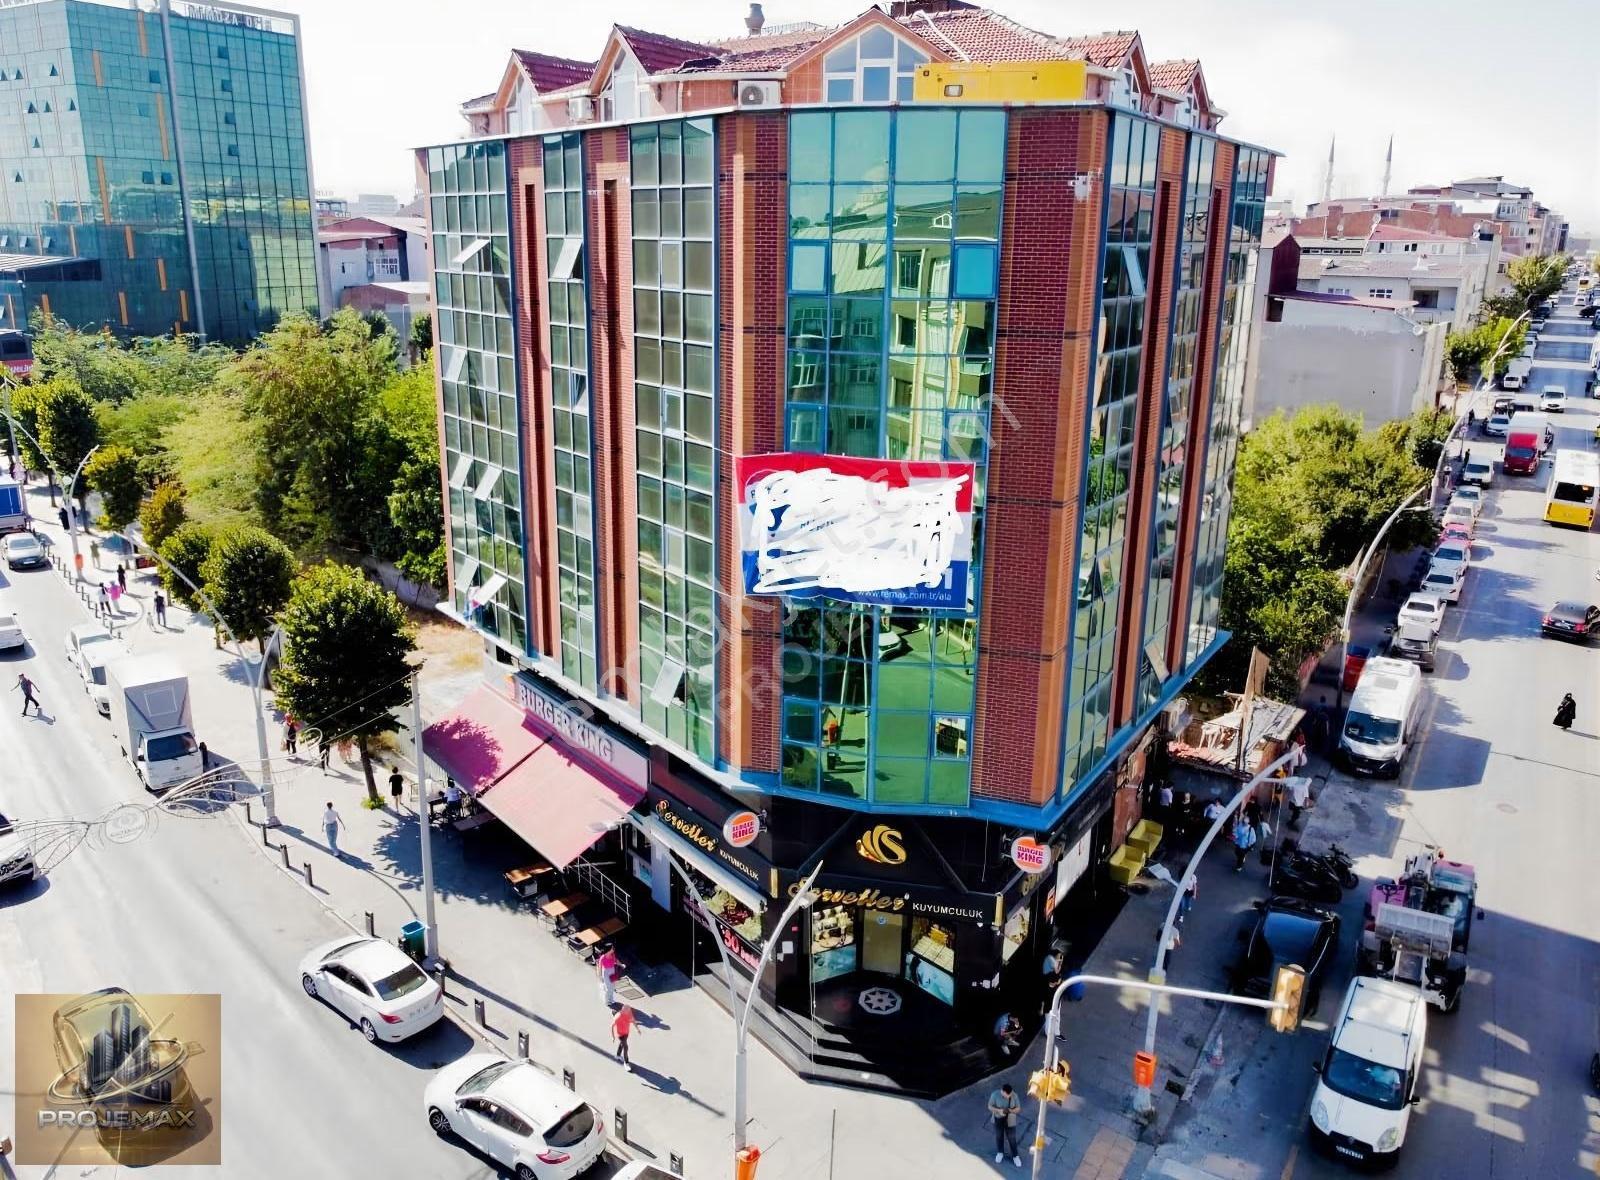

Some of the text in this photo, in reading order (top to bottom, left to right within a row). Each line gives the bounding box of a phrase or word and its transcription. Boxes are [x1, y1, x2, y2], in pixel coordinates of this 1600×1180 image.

[520, 684, 614, 761] BURGER KING
[732, 829, 755, 839] KING
[1017, 852, 1043, 864] KING
[912, 902, 983, 919] KUYUMCULUK
